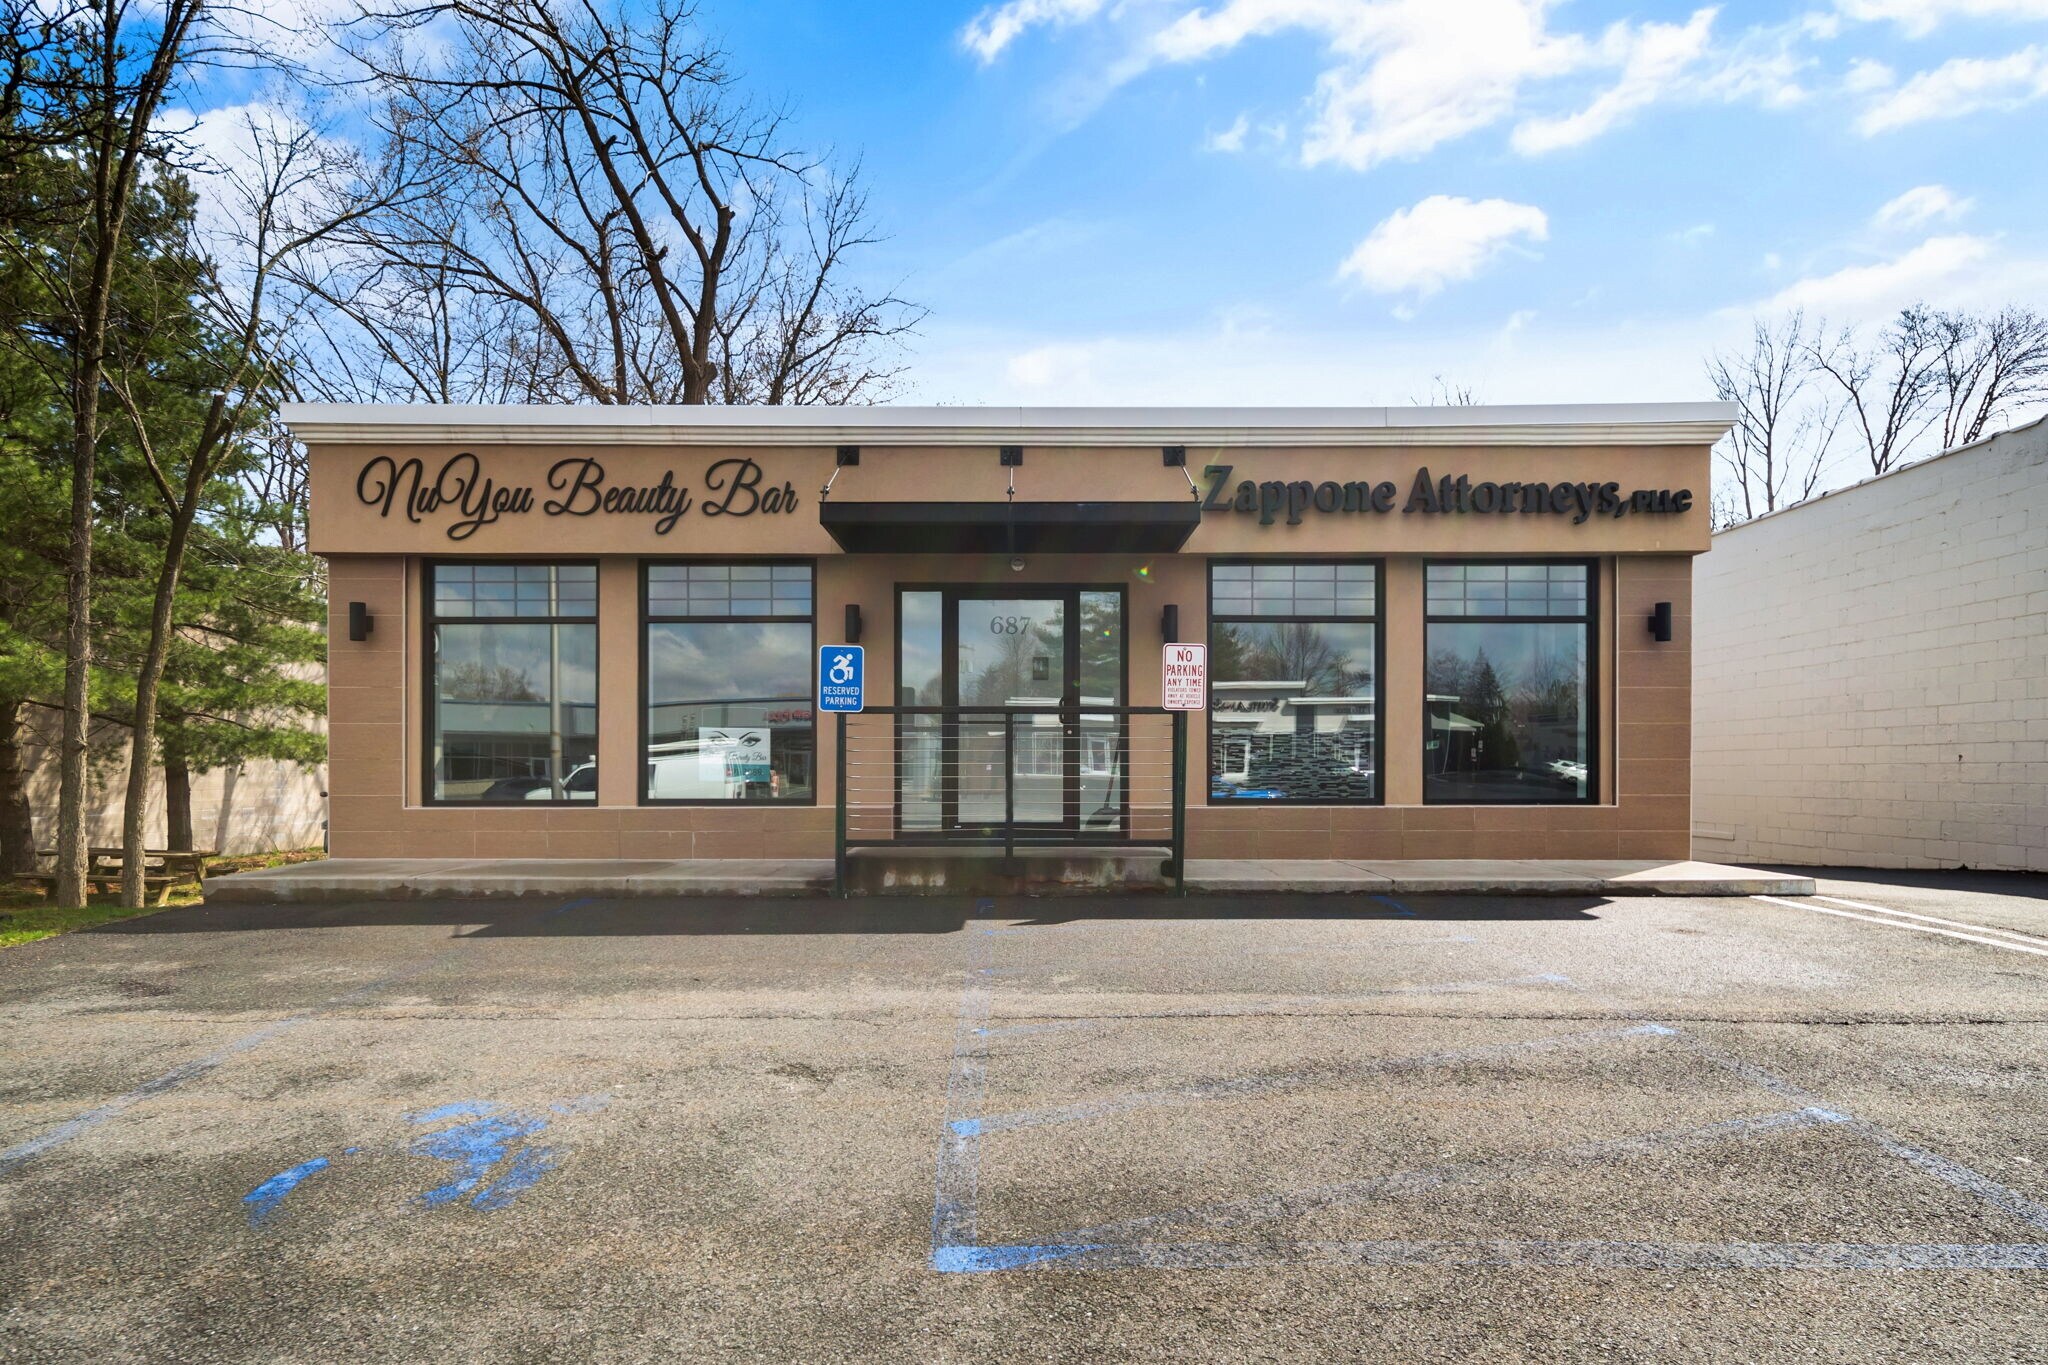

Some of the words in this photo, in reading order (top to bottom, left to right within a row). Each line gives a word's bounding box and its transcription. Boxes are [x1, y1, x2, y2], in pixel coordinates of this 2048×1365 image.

[543, 456, 693, 535] Beauty
[701, 456, 799, 517] Bar
[1200, 464, 1398, 526] Zappone
[990, 616, 1031, 635] 687
[1177, 650, 1193, 662] NO
[1166, 664, 1203, 676] PARKING
[1167, 678, 1183, 687] ANY
[1185, 678, 1202, 687] TIME
[823, 686, 860, 695] RESERVED
[825, 696, 858, 706] PARKING
